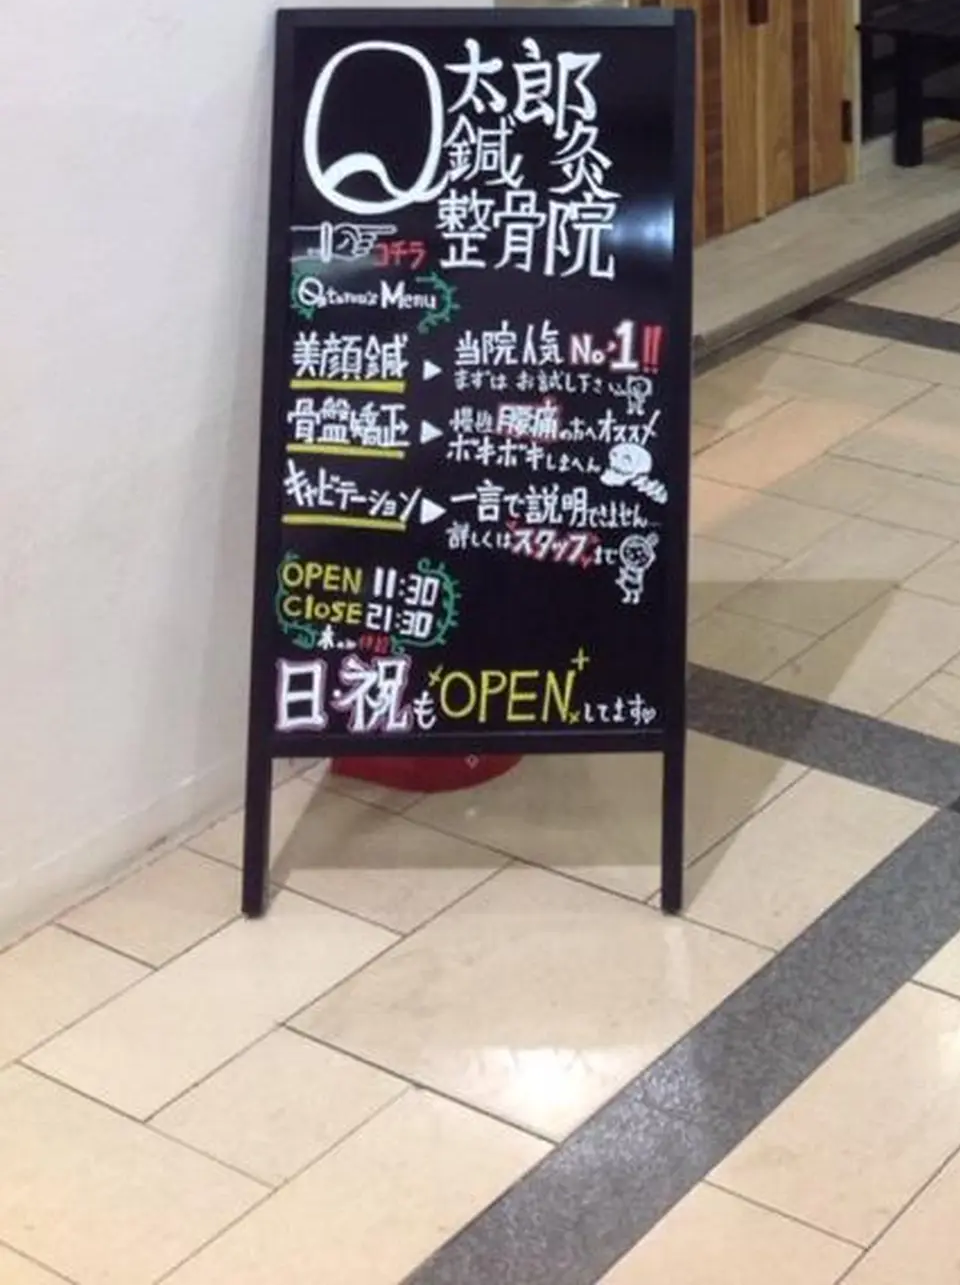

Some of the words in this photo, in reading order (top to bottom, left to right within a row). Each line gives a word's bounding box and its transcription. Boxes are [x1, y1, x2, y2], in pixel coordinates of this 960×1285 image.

[380, 279, 438, 310] Menu
[282, 561, 363, 596] OPEN
[373, 567, 440, 607] 11:30
[364, 602, 434, 639] 21:30
